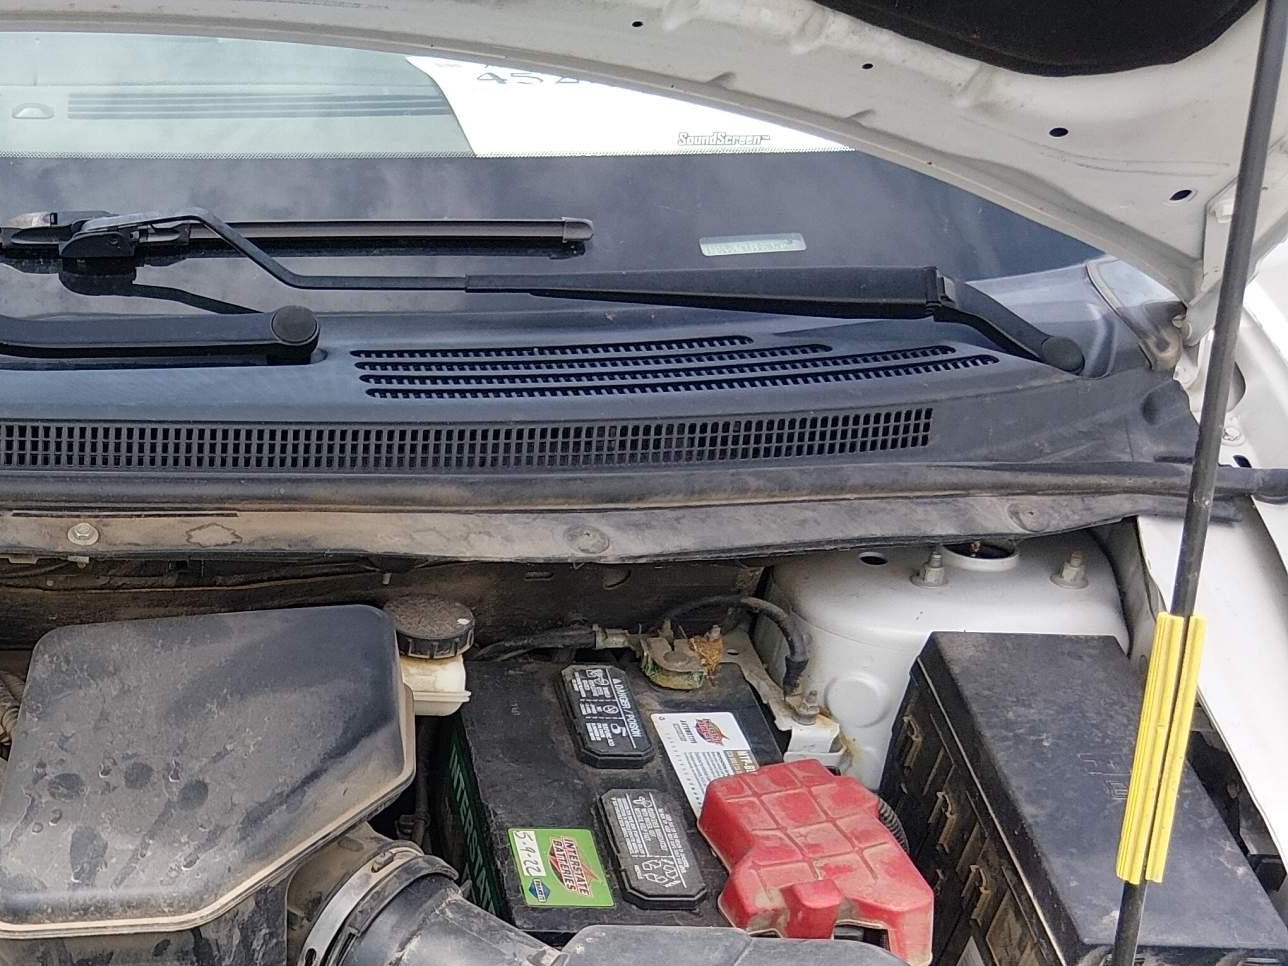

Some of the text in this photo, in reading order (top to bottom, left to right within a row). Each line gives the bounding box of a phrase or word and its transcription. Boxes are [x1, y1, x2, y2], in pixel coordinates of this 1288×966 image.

[613, 684, 631, 709] DANGER
[625, 713, 642, 737] POISON
[552, 839, 576, 890] BATTERIES
[563, 838, 590, 895] INTERSTATE
